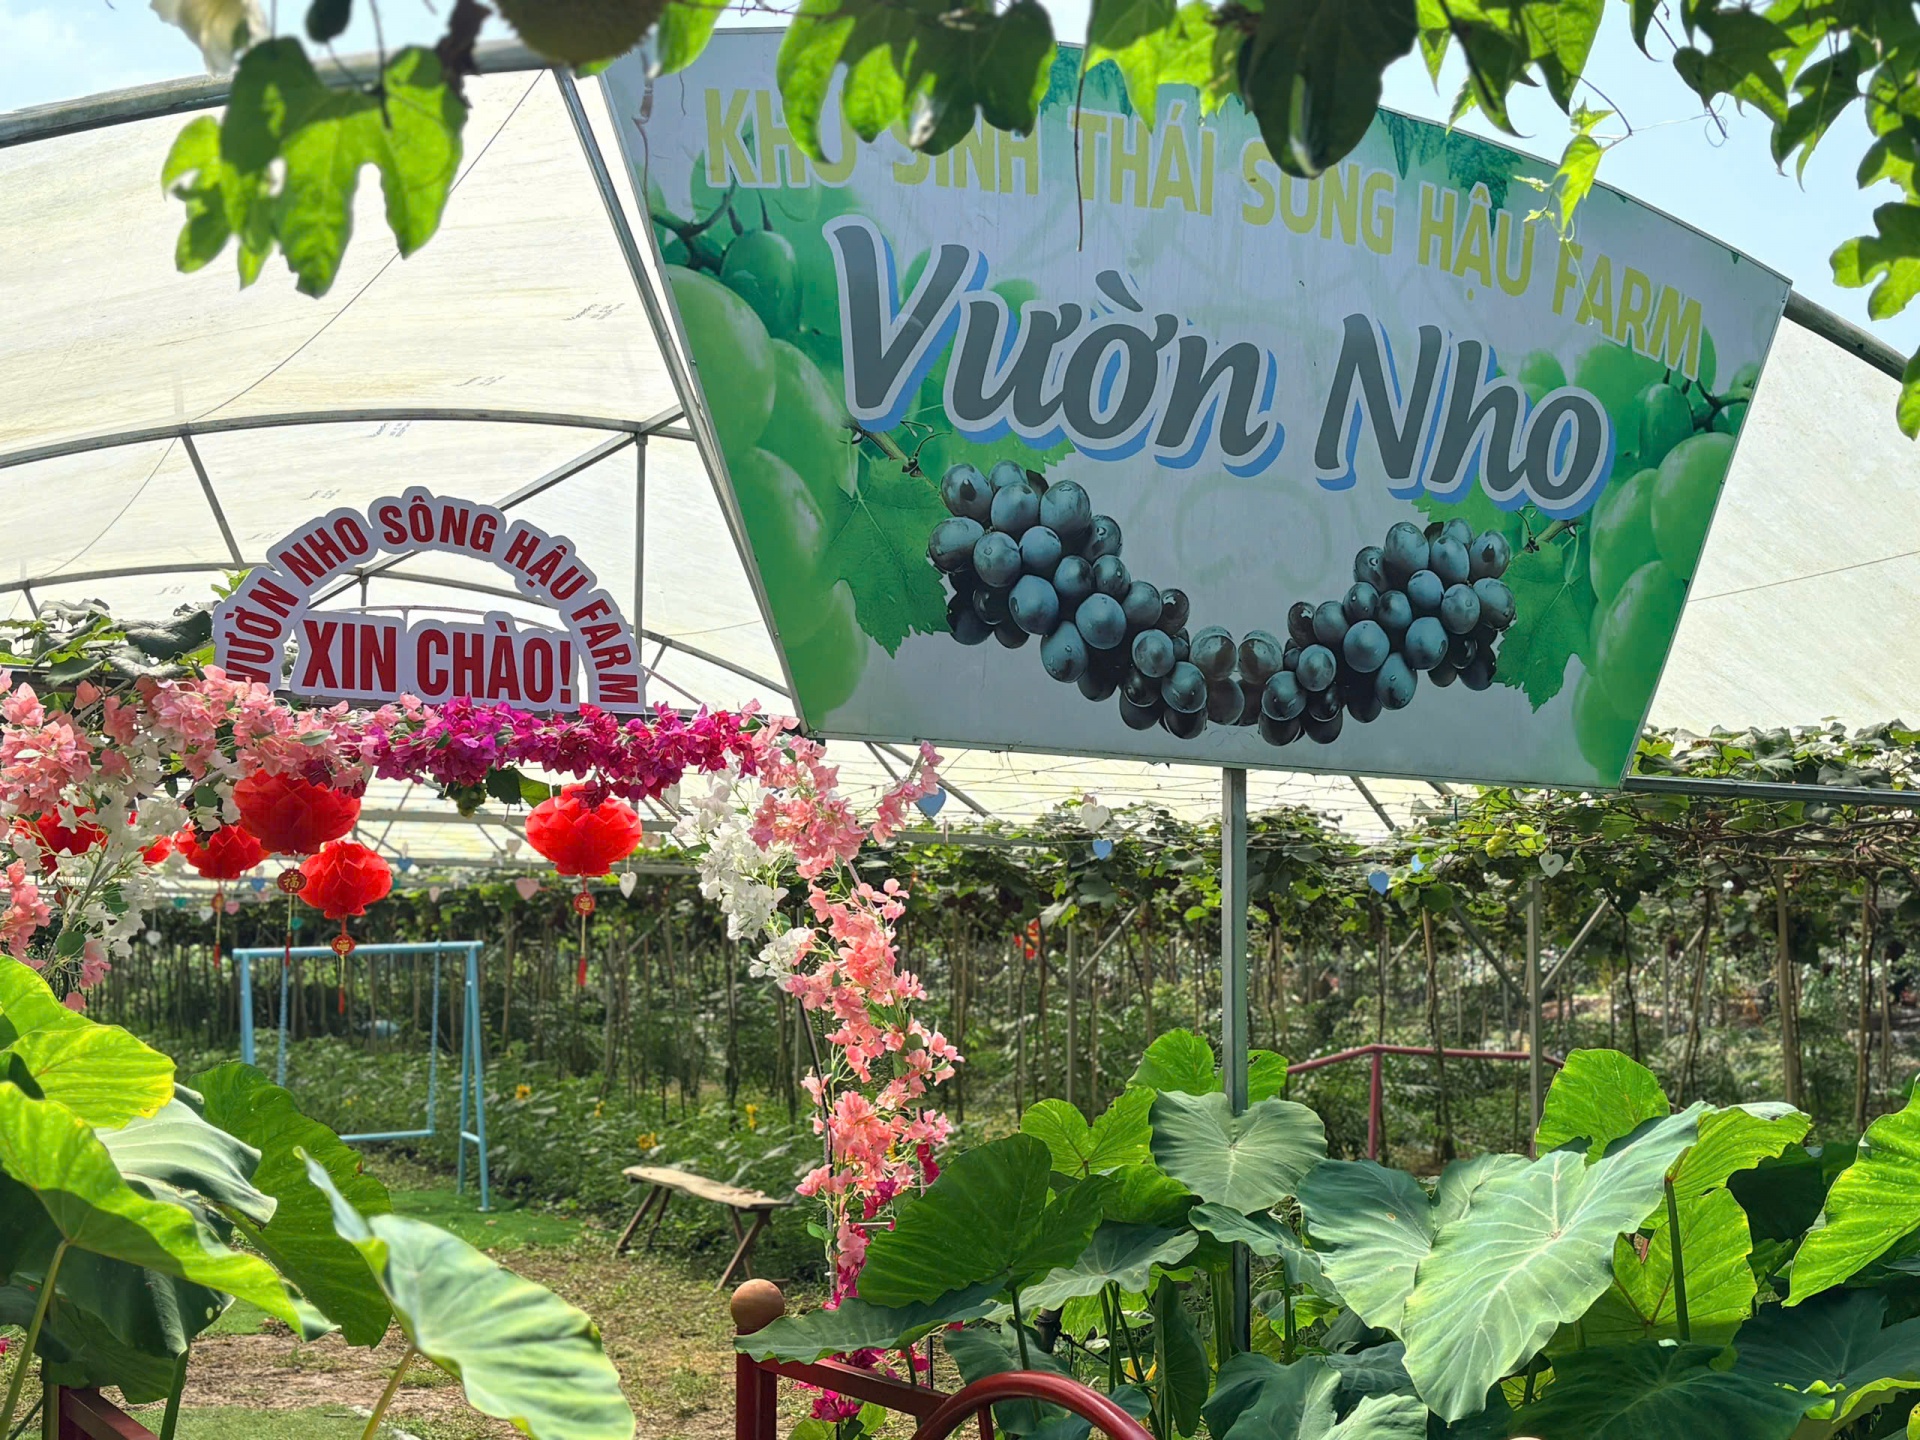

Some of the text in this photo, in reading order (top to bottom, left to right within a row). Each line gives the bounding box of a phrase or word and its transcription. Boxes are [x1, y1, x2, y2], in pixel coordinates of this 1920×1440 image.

[1069, 103, 1215, 216] THÁI
[1417, 184, 1535, 301] HẬU
[1551, 243, 1702, 376] FARM
[829, 223, 1602, 500] Vườn Nho
[223, 495, 639, 704] VƯỜN NHO SÔNG HẬU FARM
[302, 619, 572, 705] XIN CHÀO!
[283, 873, 300, 889] 福
